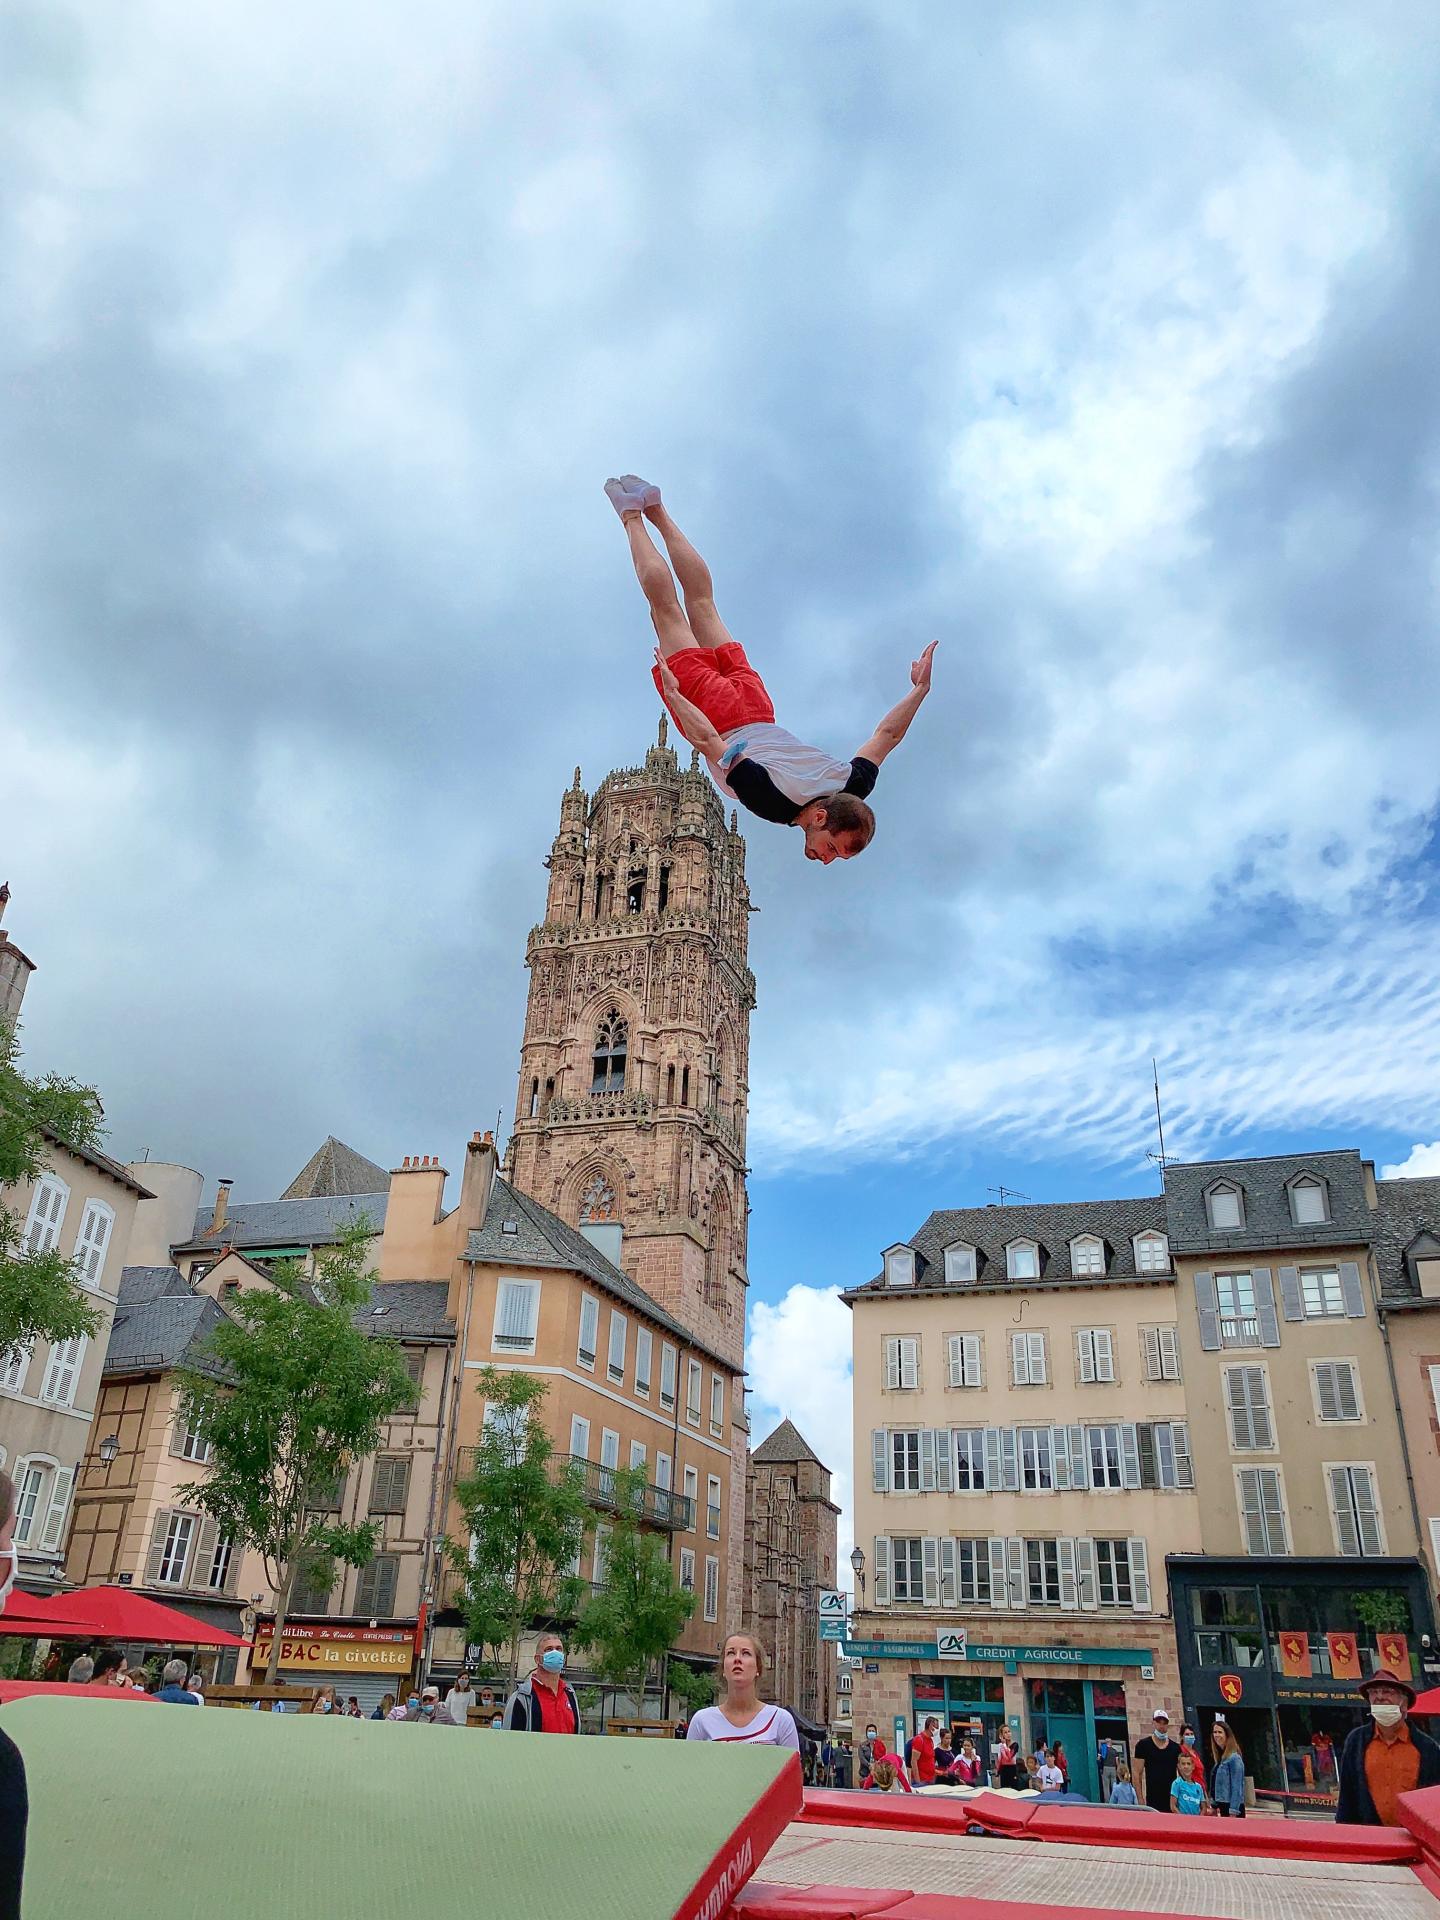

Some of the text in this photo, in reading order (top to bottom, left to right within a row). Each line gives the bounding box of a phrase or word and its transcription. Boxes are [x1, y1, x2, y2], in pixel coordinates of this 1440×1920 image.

[259, 1642, 406, 1664] TBAC la civette
[1024, 1649, 1082, 1661] AGRICOLE
